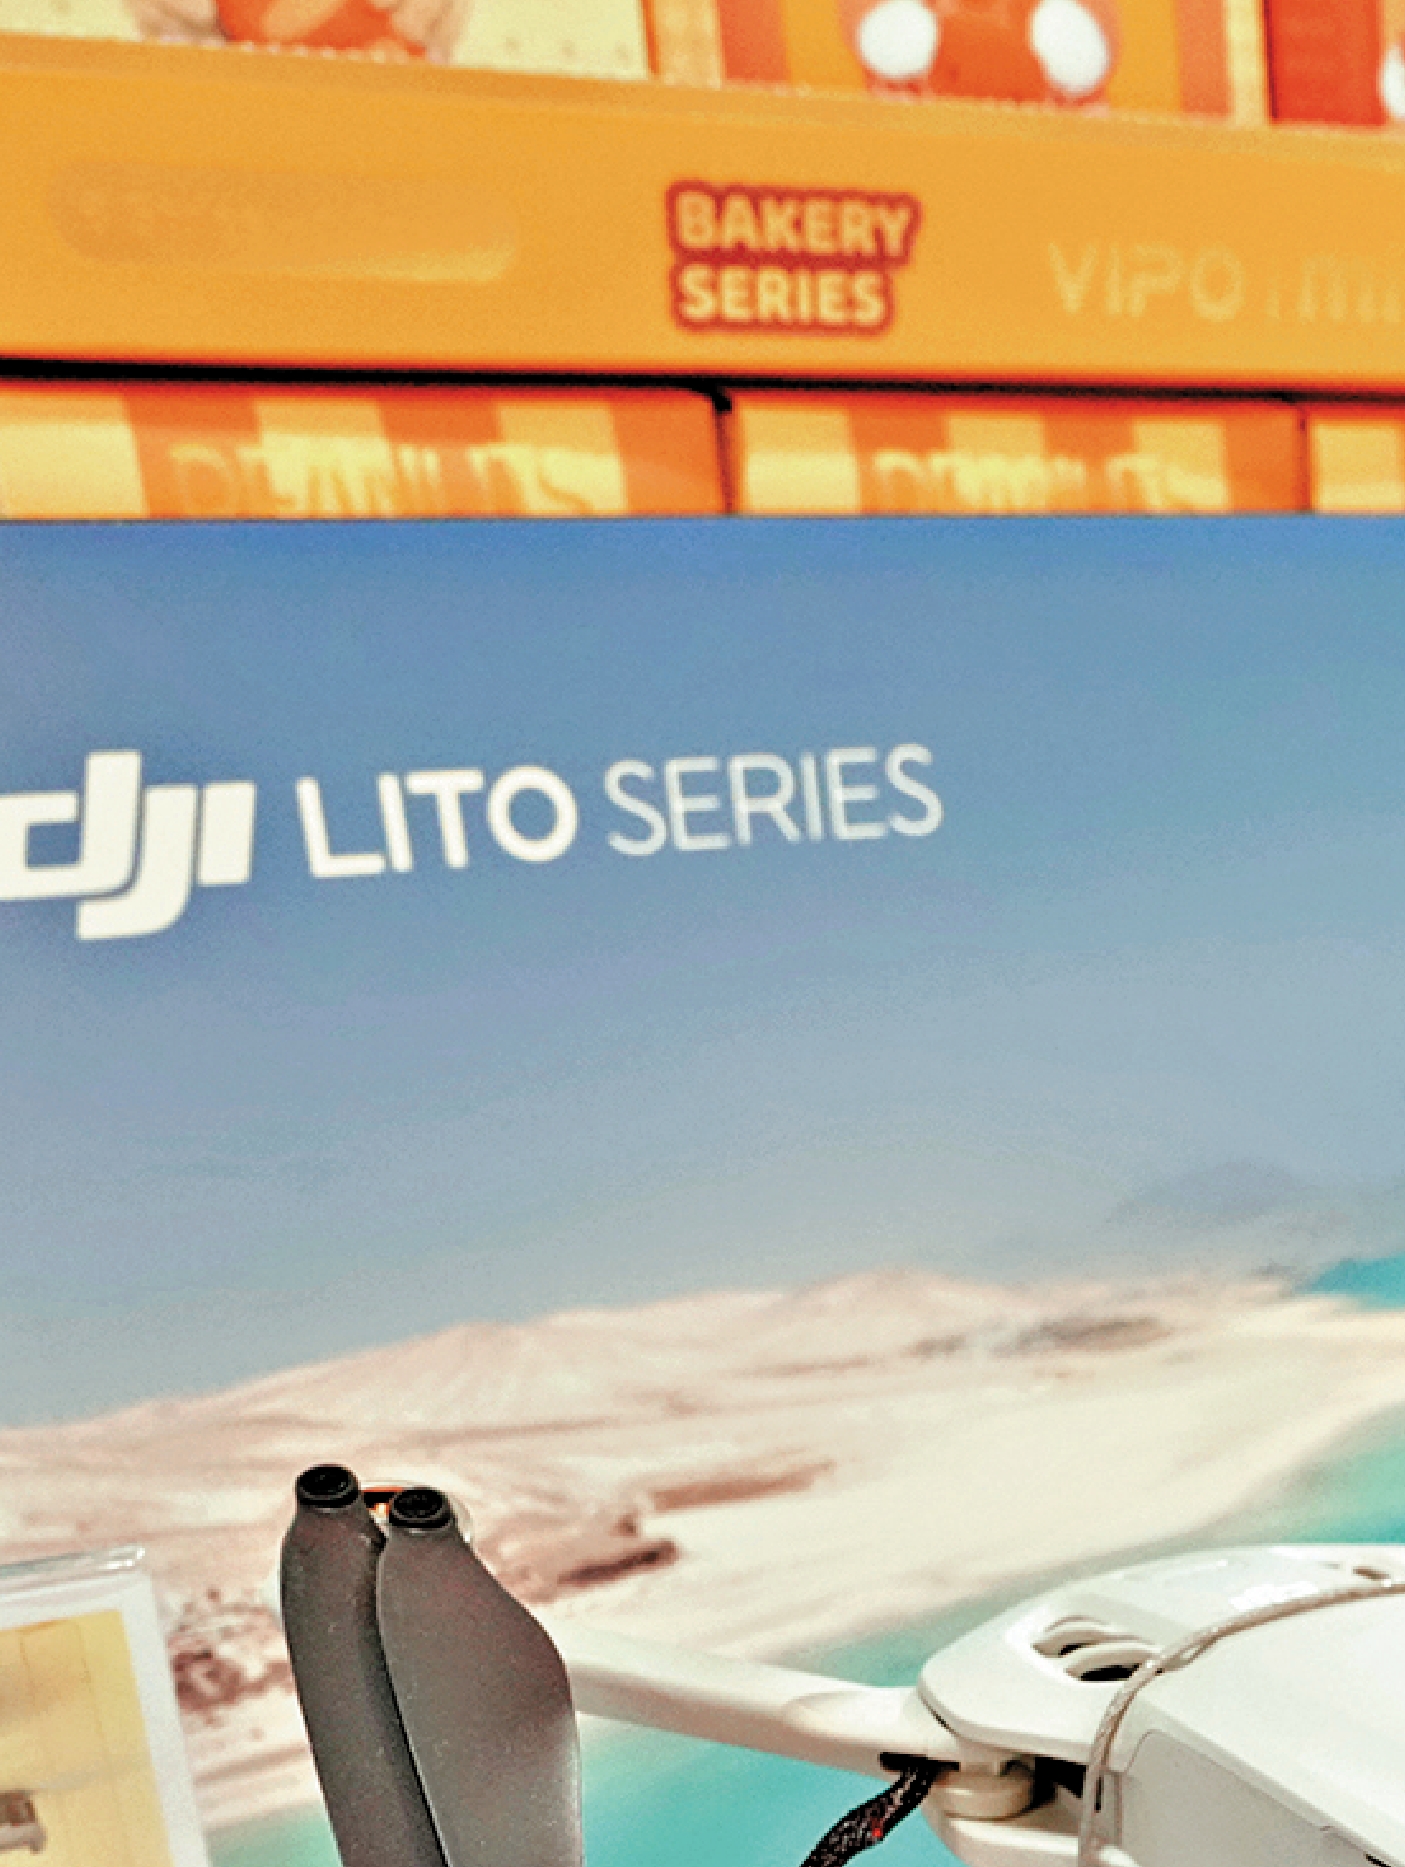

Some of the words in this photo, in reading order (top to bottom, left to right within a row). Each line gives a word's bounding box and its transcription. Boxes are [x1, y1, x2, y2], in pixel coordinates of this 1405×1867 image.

[673, 187, 912, 258] BAKERY
[679, 263, 885, 327] SERIES
[297, 765, 579, 878] LITO
[604, 744, 944, 855] SERIES
